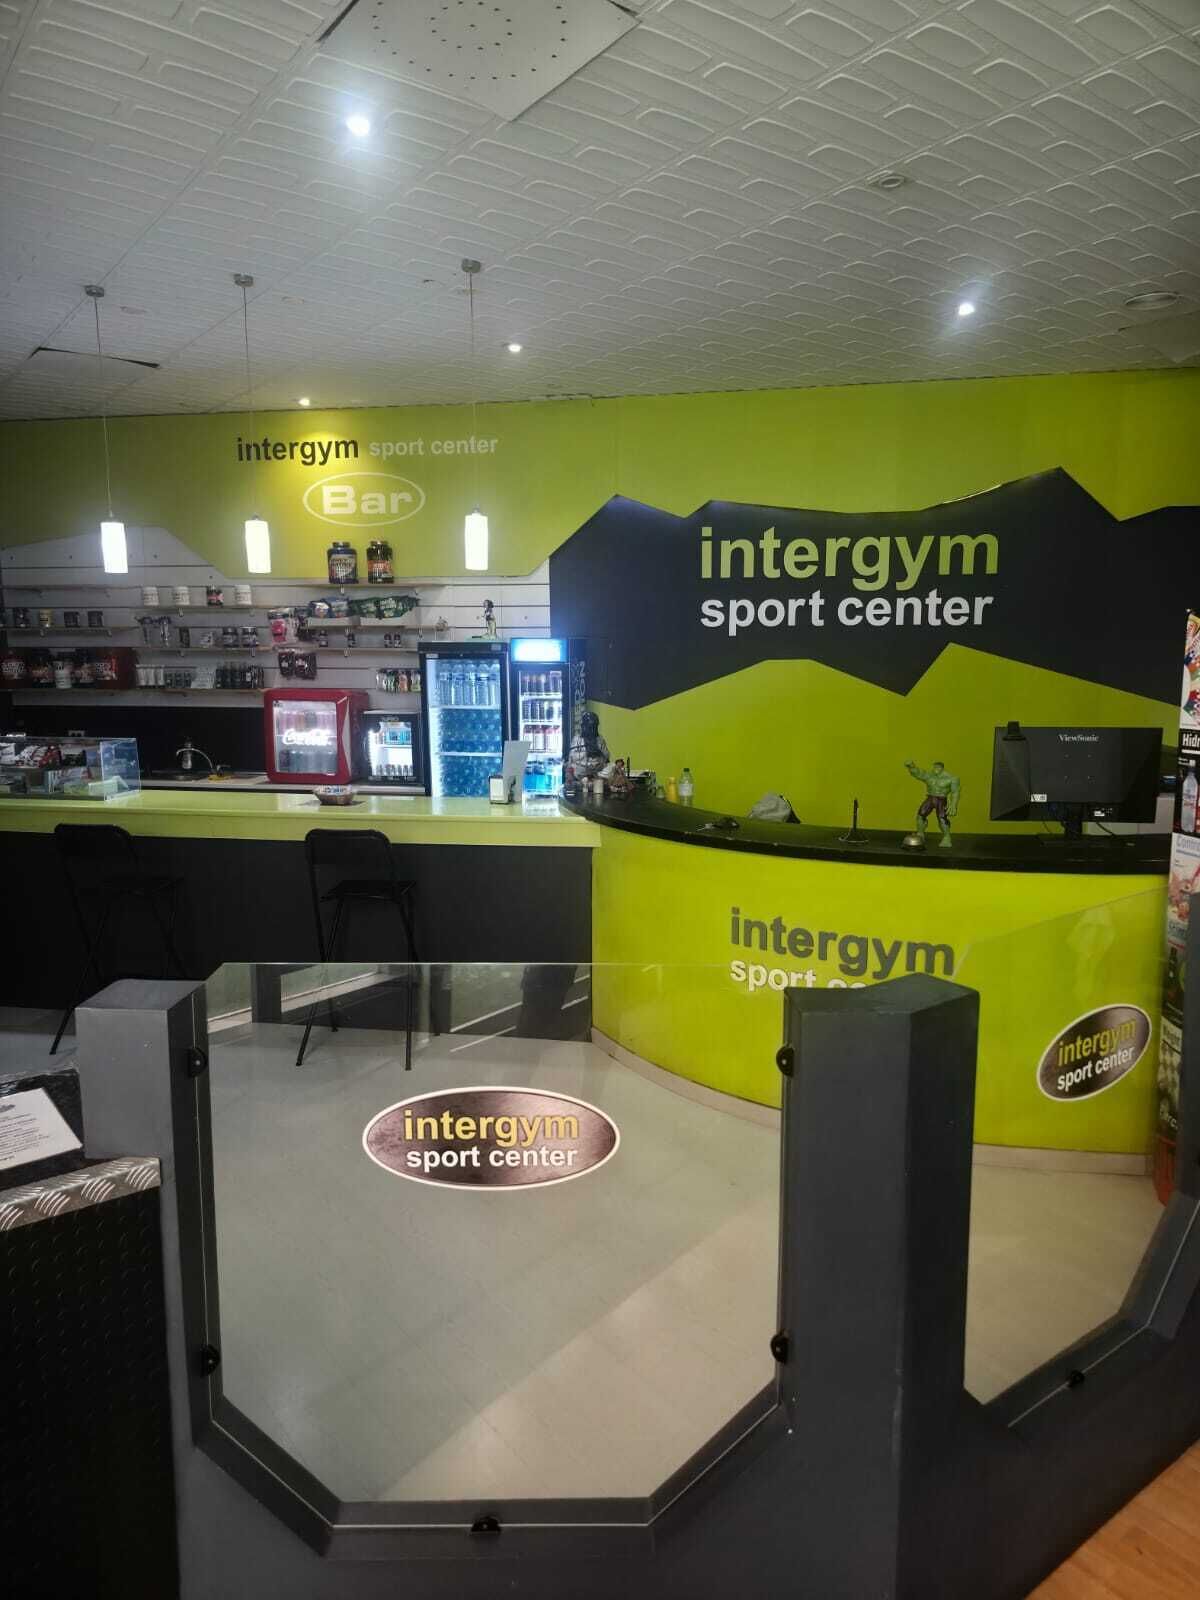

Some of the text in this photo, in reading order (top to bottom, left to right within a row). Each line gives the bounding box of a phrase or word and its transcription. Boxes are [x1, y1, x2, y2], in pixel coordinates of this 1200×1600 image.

[237, 436, 498, 465] intergym sport center
[321, 485, 412, 515] Bar
[701, 526, 999, 591] intergym
[700, 587, 995, 637] sport center
[1058, 733, 1100, 743] ViewSonic
[731, 906, 955, 980] intergym
[730, 959, 817, 992] sport
[1057, 1018, 1138, 1067] intergym
[1056, 1046, 1136, 1092] sport center
[403, 1109, 579, 1148] intergym
[406, 1146, 578, 1173] sport center
